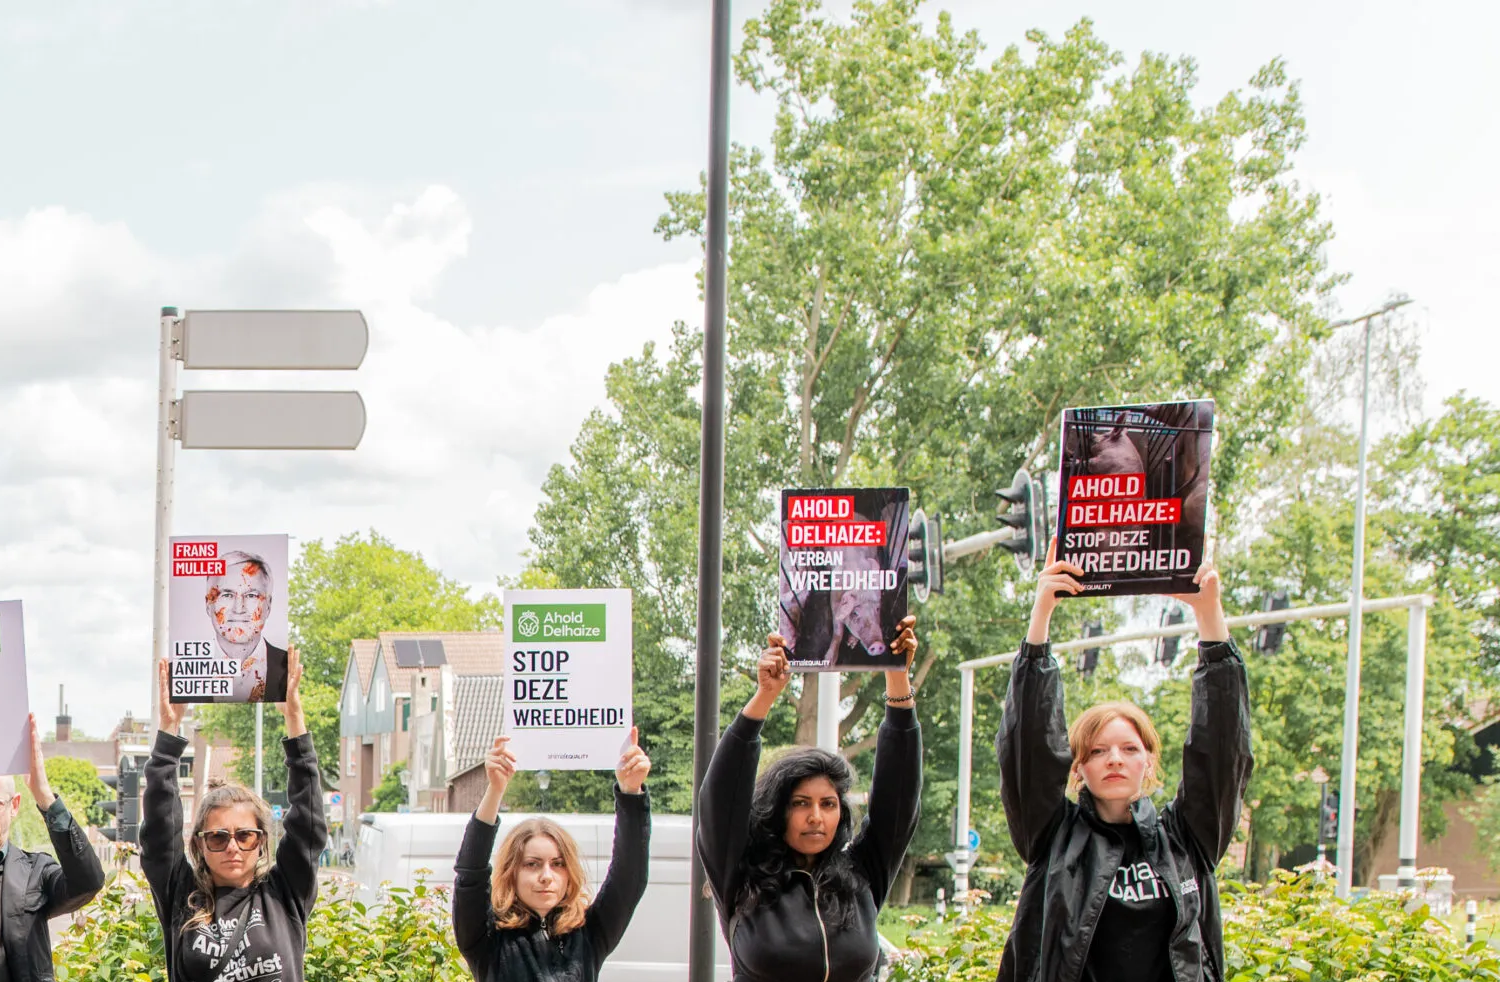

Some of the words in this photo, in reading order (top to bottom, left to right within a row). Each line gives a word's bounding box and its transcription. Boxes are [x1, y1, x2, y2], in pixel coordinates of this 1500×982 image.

[1072, 476, 1140, 498] AHOLD
[792, 499, 849, 518] AHOLD
[1071, 502, 1174, 524] DELHAIZE:
[791, 525, 881, 545] DELHAIZE:
[1065, 532, 1106, 548] STOP
[1109, 530, 1149, 547] DEZE
[176, 544, 215, 557] FRANS
[789, 551, 843, 566] VERBAN
[176, 562, 222, 574] MULLER
[1064, 549, 1190, 573] WREEDHEID
[788, 570, 897, 591] WREEDHEID
[544, 612, 583, 624] Ahold
[544, 625, 600, 637] Delhaize
[176, 642, 210, 656] LETS
[175, 661, 237, 675] ANIMALS
[513, 651, 569, 672] STOP
[175, 680, 228, 694] SUFFER
[514, 679, 568, 700] DEZE
[513, 708, 623, 726] WREEDHEID!
